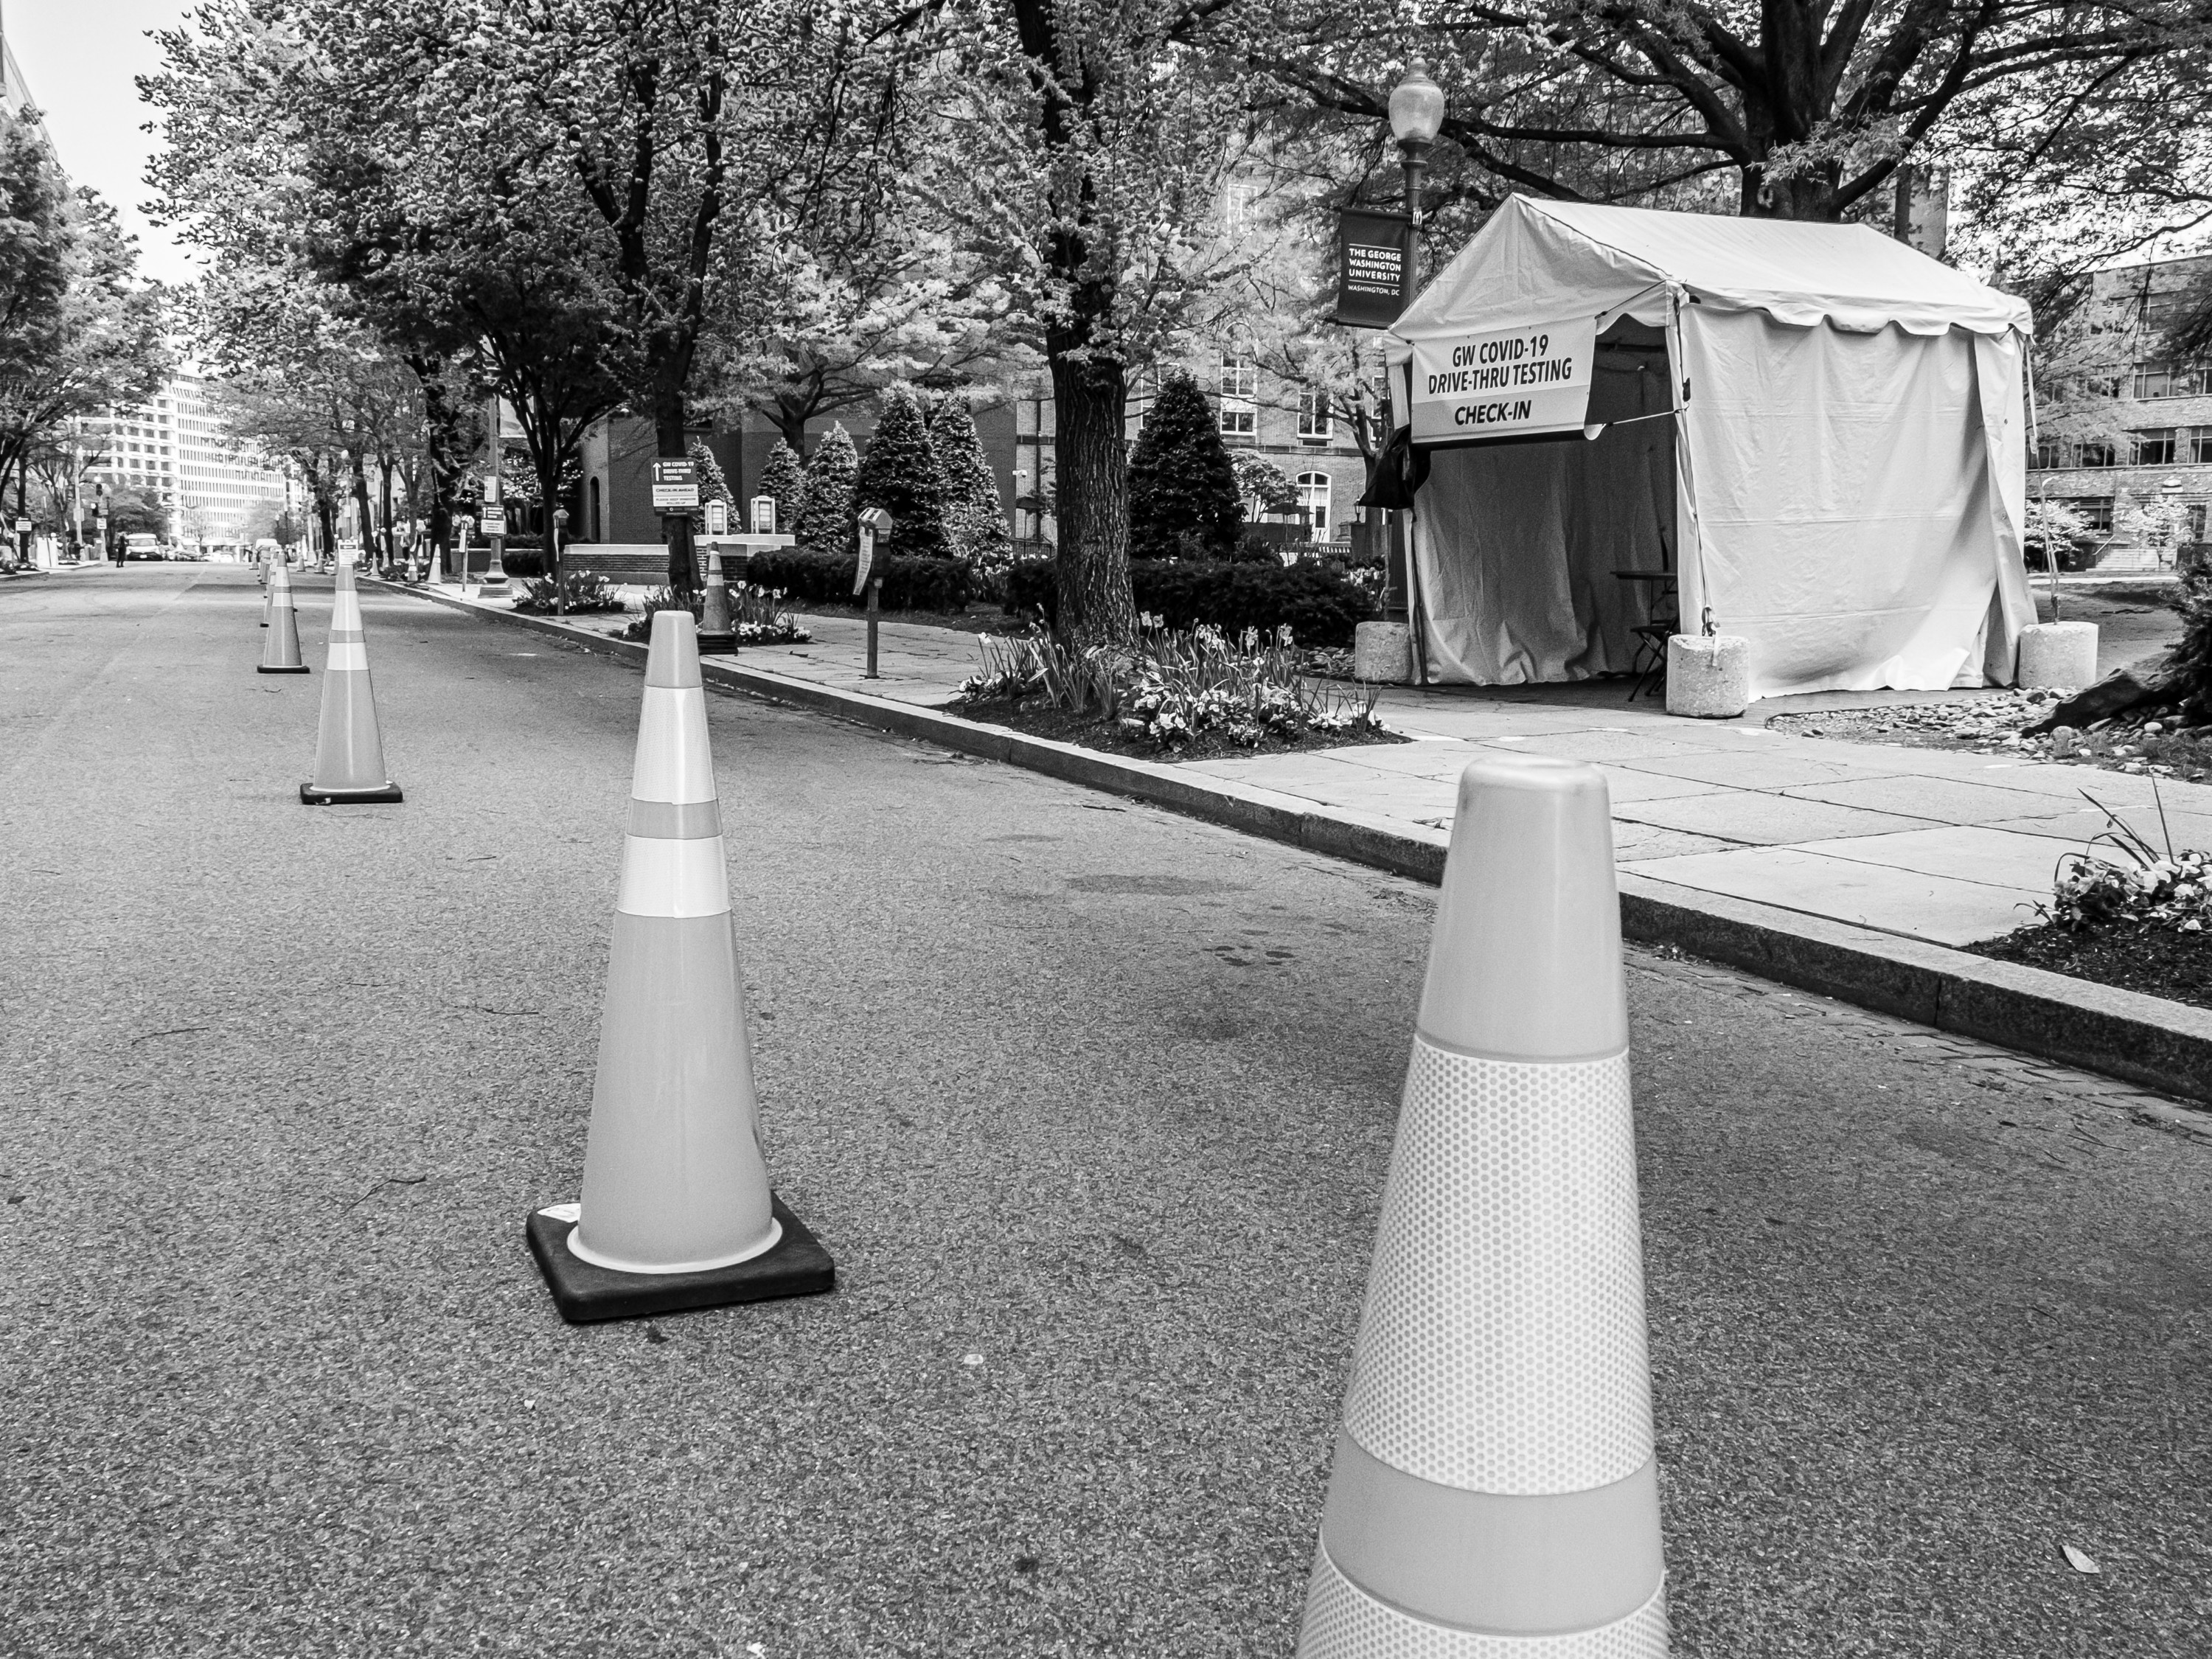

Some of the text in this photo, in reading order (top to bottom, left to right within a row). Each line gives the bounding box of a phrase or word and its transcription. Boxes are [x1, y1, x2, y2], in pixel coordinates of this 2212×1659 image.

[1349, 248, 1402, 262] THE GEORGE
[1349, 258, 1401, 272] WASHINGTON
[1349, 268, 1400, 282] UNIVERSITY
[1348, 285, 1390, 296] WASHINGTON,
[1453, 334, 1549, 367] GW COVID-19
[1428, 357, 1573, 394] DRIVE-THRU TESTING
[1454, 400, 1532, 426] CHECK-IN
